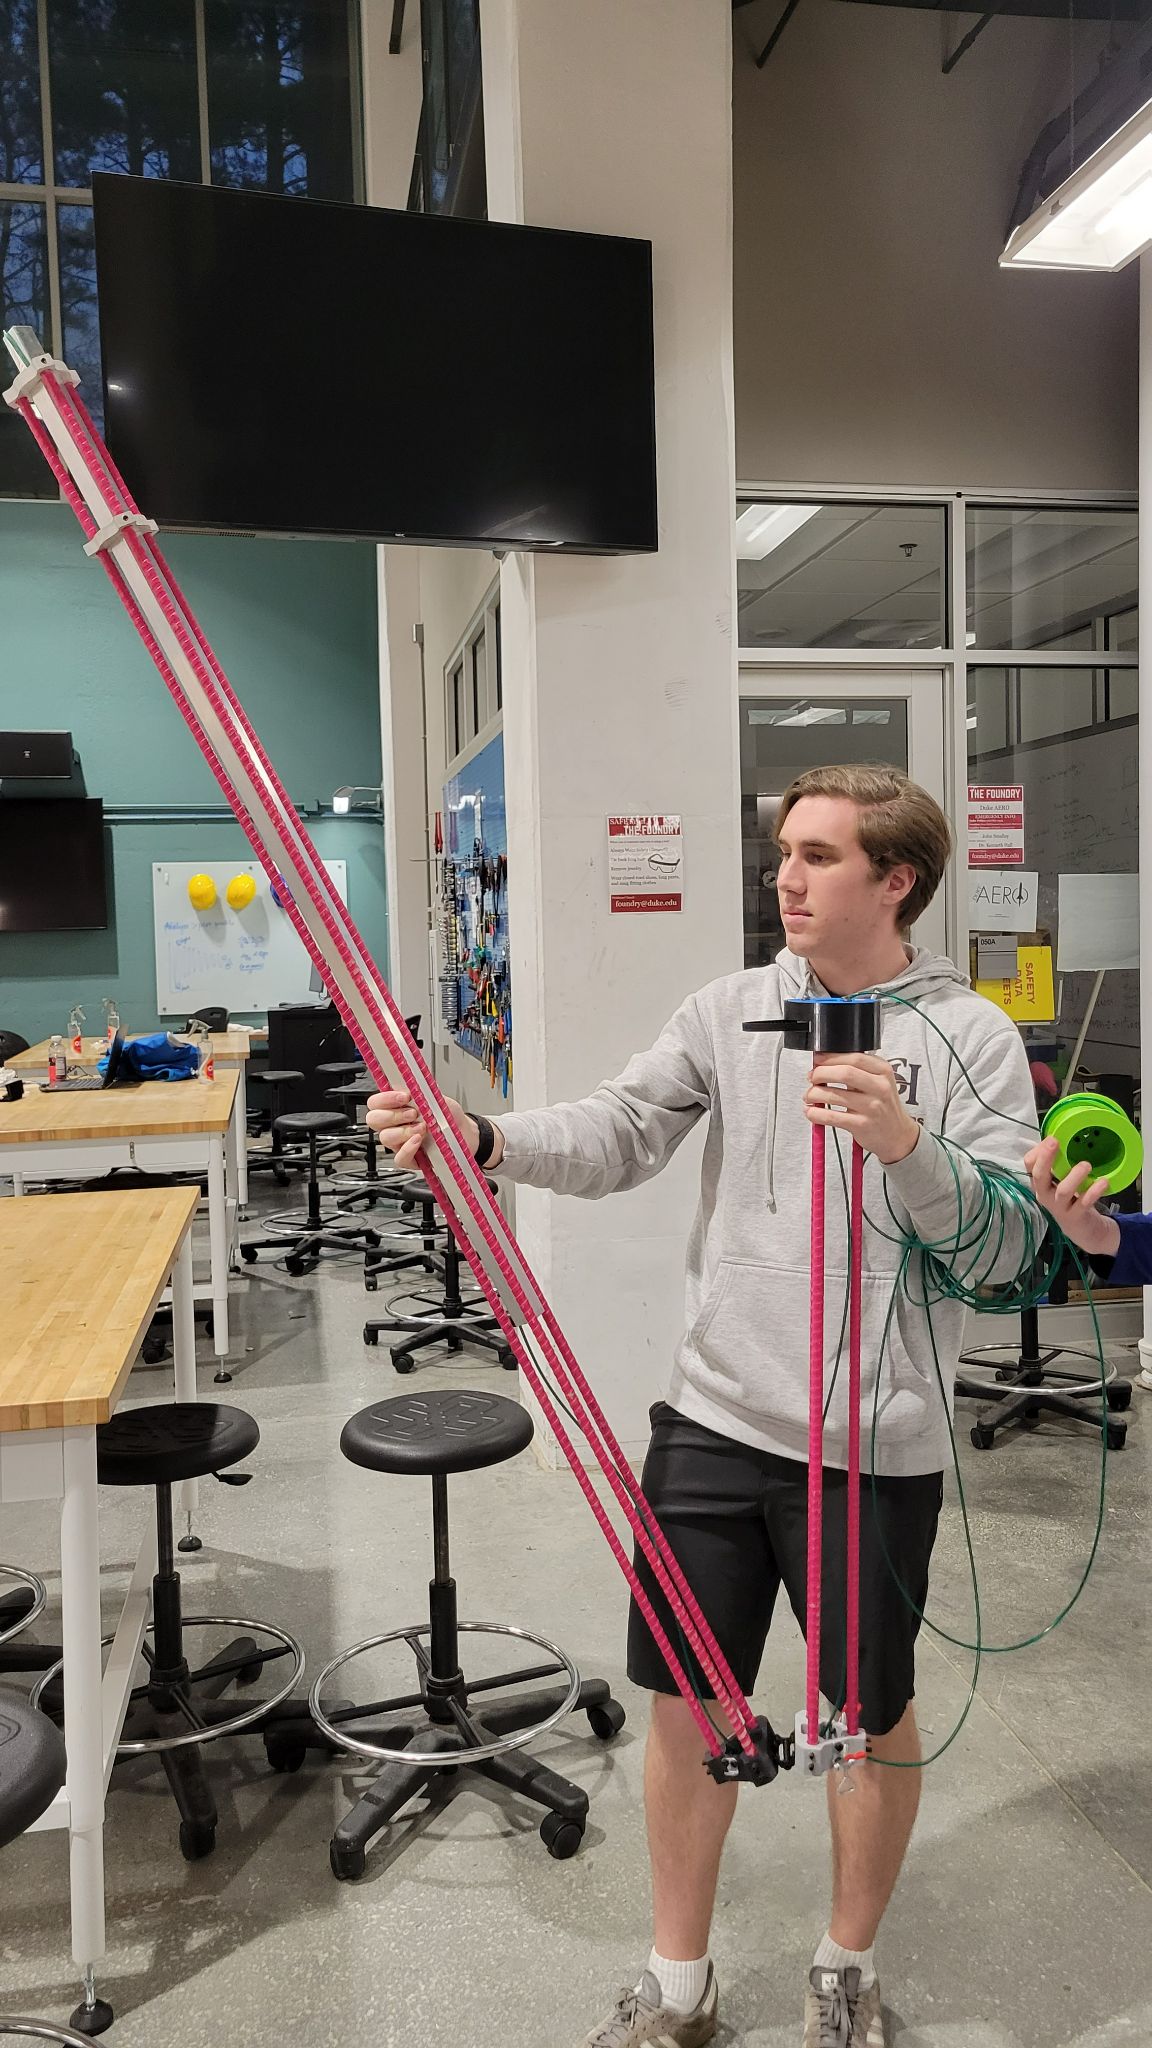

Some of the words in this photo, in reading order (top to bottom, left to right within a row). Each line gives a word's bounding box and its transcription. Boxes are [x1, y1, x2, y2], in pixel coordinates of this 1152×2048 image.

[970, 789, 984, 798] THE
[986, 788, 1020, 798] FOUNDRY
[624, 825, 640, 836] THE
[642, 825, 679, 836] FOUNDRY
[615, 899, 677, 908] foundry@duke.edu
[1025, 962, 1035, 1004] SAFETY
